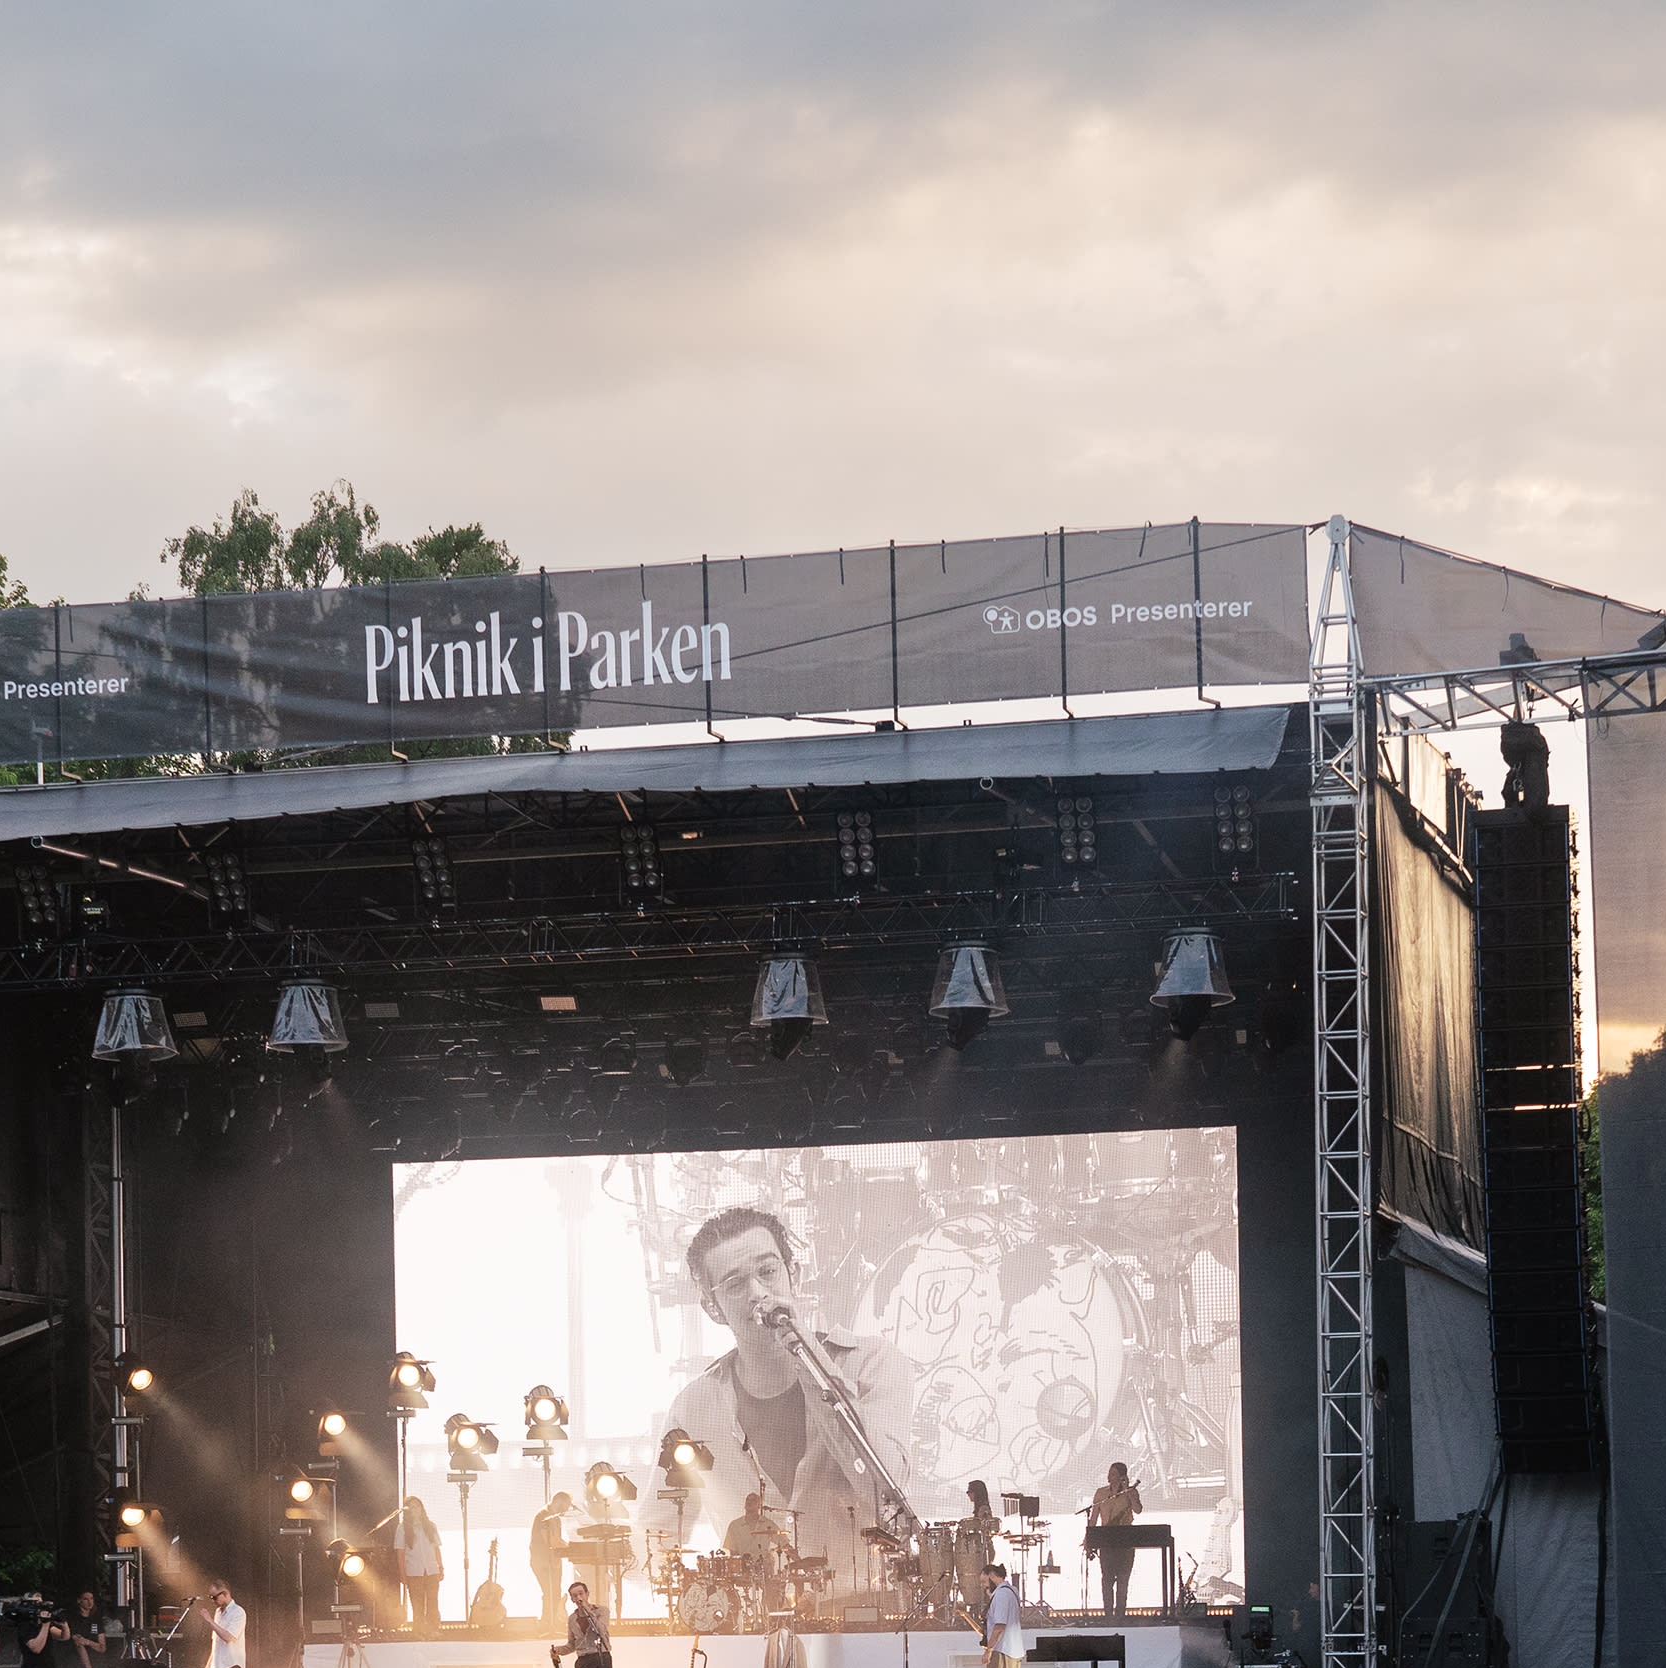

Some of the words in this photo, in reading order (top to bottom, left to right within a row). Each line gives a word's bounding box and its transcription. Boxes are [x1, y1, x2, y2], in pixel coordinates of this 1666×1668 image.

[1025, 606, 1097, 630] OBOS
[1111, 600, 1252, 625] Presenterer
[365, 611, 521, 704] Piknik
[532, 616, 545, 693] i
[557, 600, 732, 692] Parken
[4, 677, 130, 700] Presenterer
